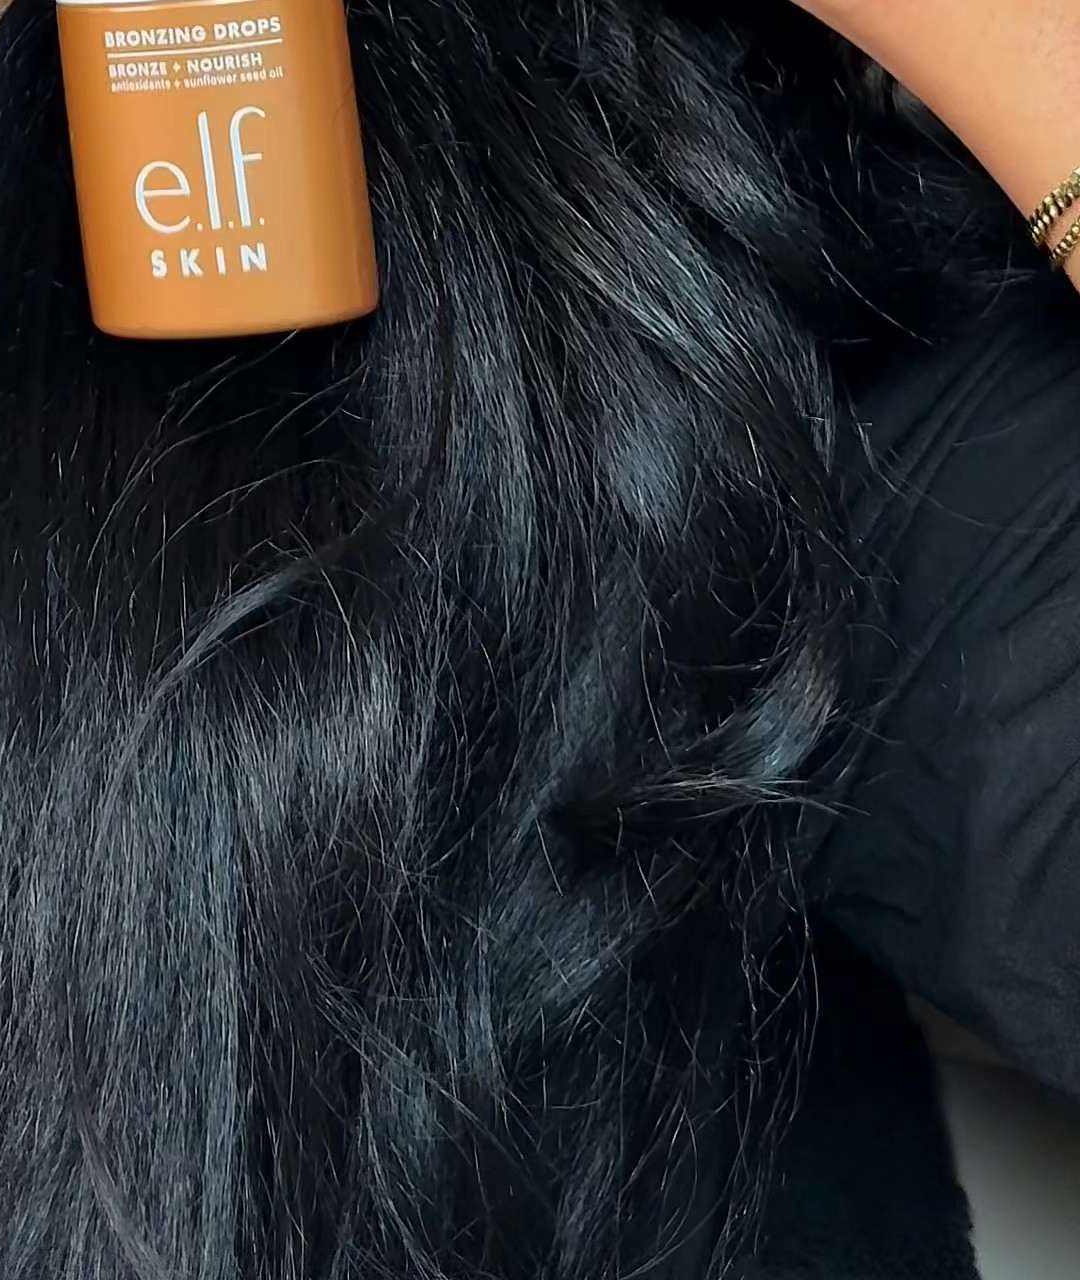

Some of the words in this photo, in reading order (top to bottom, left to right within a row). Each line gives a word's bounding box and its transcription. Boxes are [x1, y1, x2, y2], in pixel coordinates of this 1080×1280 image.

[104, 25, 207, 48] BRONZING
[213, 16, 281, 40] DROPS
[108, 61, 168, 78] BRONZE
[172, 62, 181, 73] +
[186, 52, 263, 74] NOURISH
[111, 78, 171, 93] antioxidants
[174, 79, 181, 89] +
[183, 73, 238, 88] sunflower
[240, 67, 267, 81] seed
[269, 65, 283, 79] oil
[150, 242, 268, 279] SKIN
